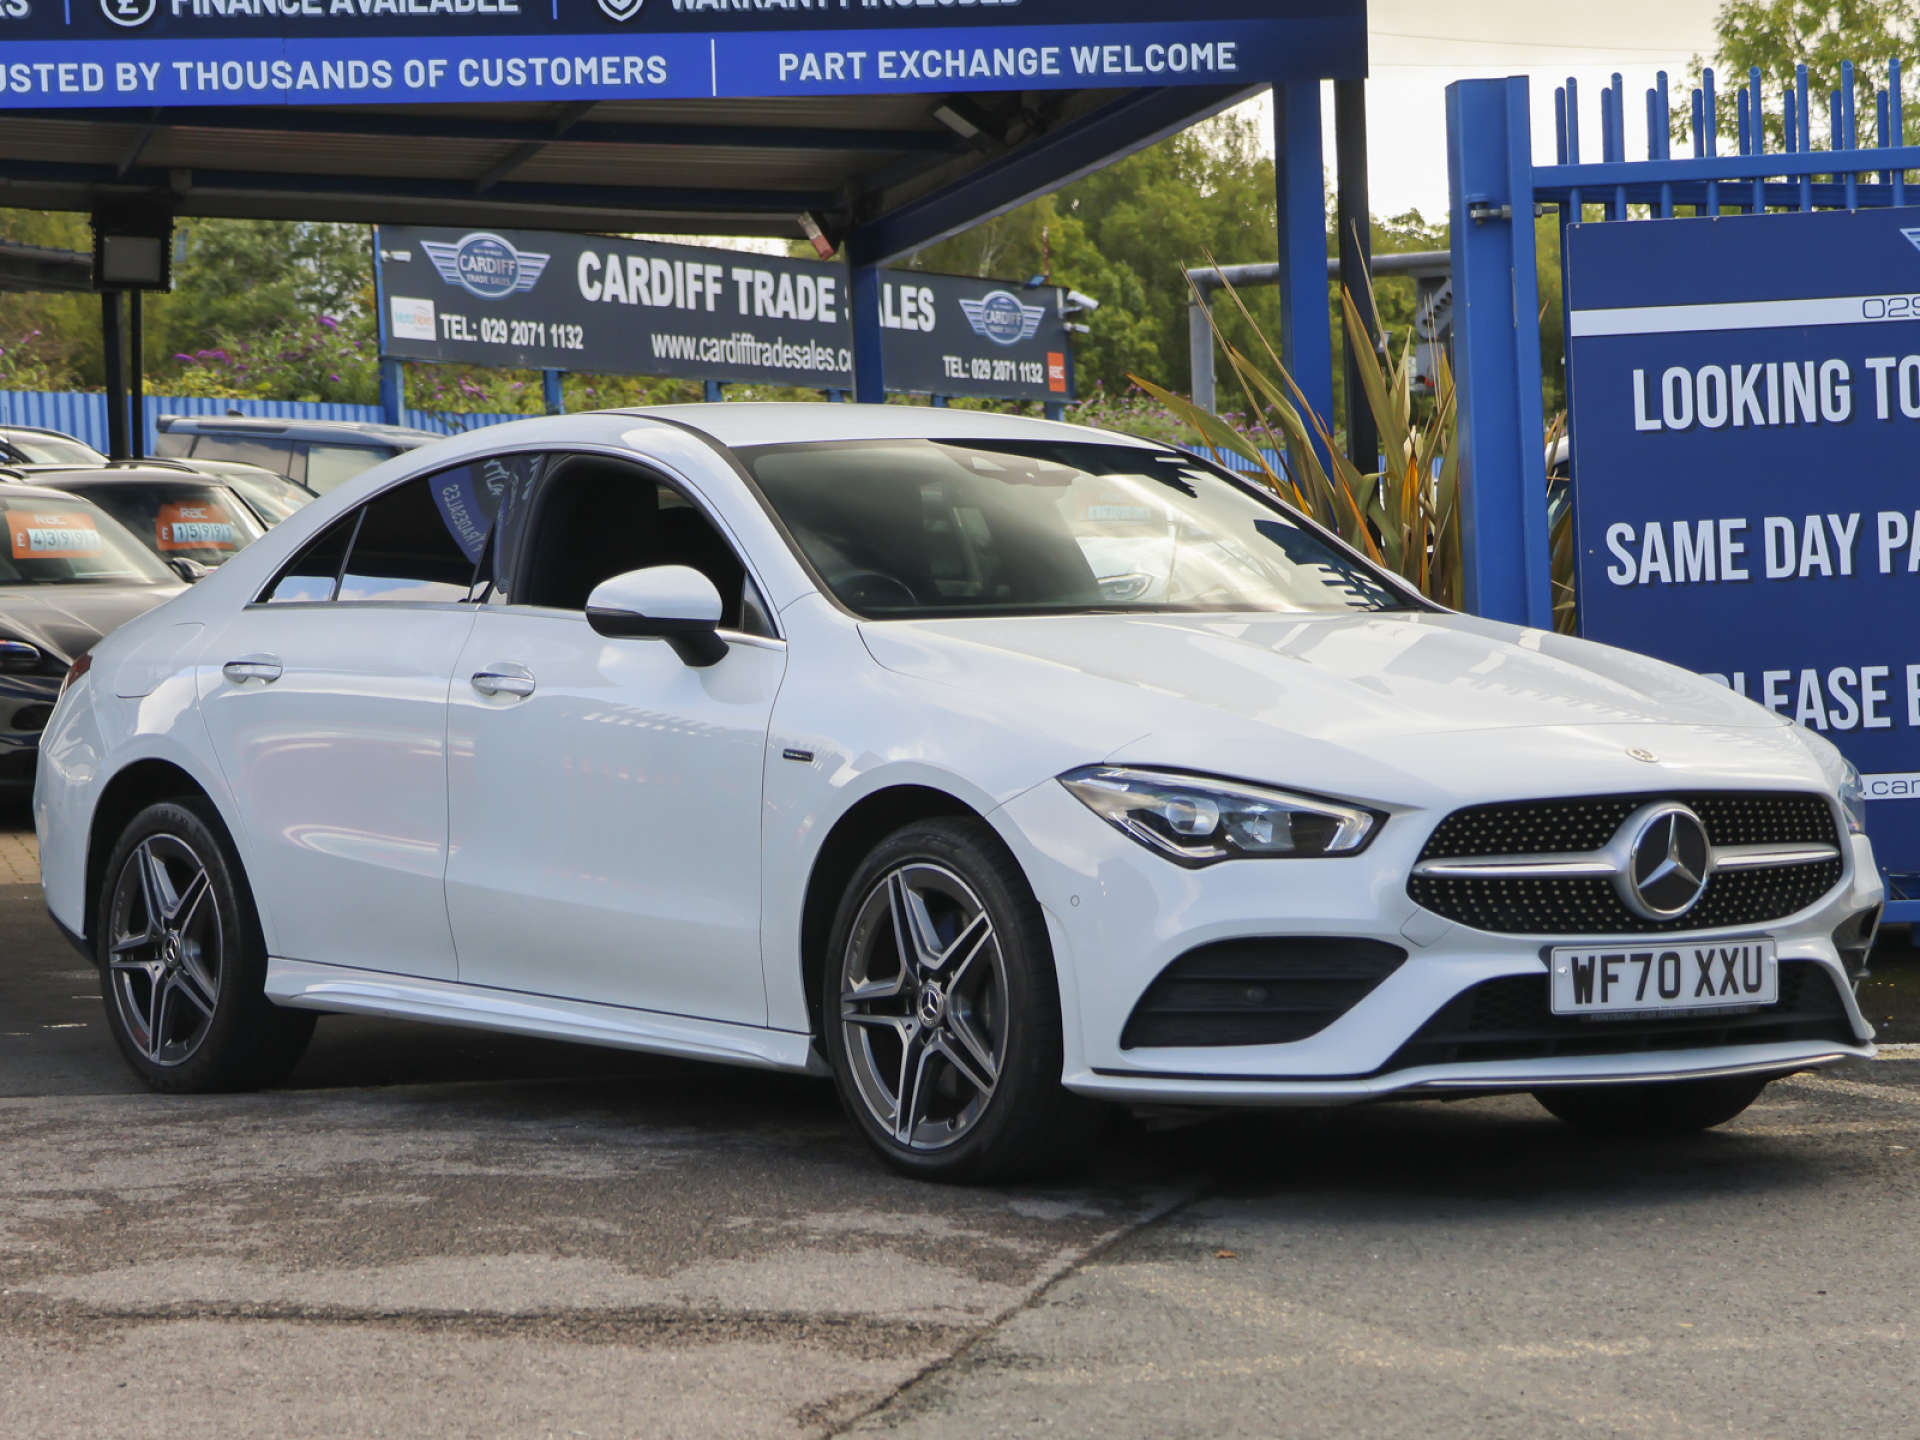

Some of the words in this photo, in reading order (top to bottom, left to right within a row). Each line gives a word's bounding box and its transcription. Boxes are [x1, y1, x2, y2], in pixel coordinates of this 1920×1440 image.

[115, 62, 161, 92] BY
[172, 58, 393, 91] THOUSANDS
[403, 59, 446, 88] OF
[457, 55, 667, 88] CUSTOMERS
[778, 51, 867, 81] PART
[877, 46, 1059, 79] EXCHANGE
[1070, 42, 1237, 75] WELCOME
[460, 254, 516, 276] CARDIFF
[577, 250, 722, 312] CARDIFF
[731, 267, 837, 323] TRADE
[844, 282, 936, 332] LES
[439, 313, 478, 342] TEL:
[480, 317, 509, 344] 029
[511, 320, 546, 347] 2071
[550, 322, 584, 350] 1132
[942, 354, 970, 379] TEL:
[971, 357, 992, 381] 029
[992, 359, 1018, 383] 2071
[1019, 361, 1044, 384] 1132
[1633, 358, 1851, 431] LOOKING
[1865, 354, 1920, 420] TO
[1606, 518, 1749, 586] SAME
[1764, 512, 1861, 579] DAY
[1700, 665, 1891, 731] EASE
[1571, 951, 1682, 1005] WF70
[1694, 946, 1764, 999] XXU
